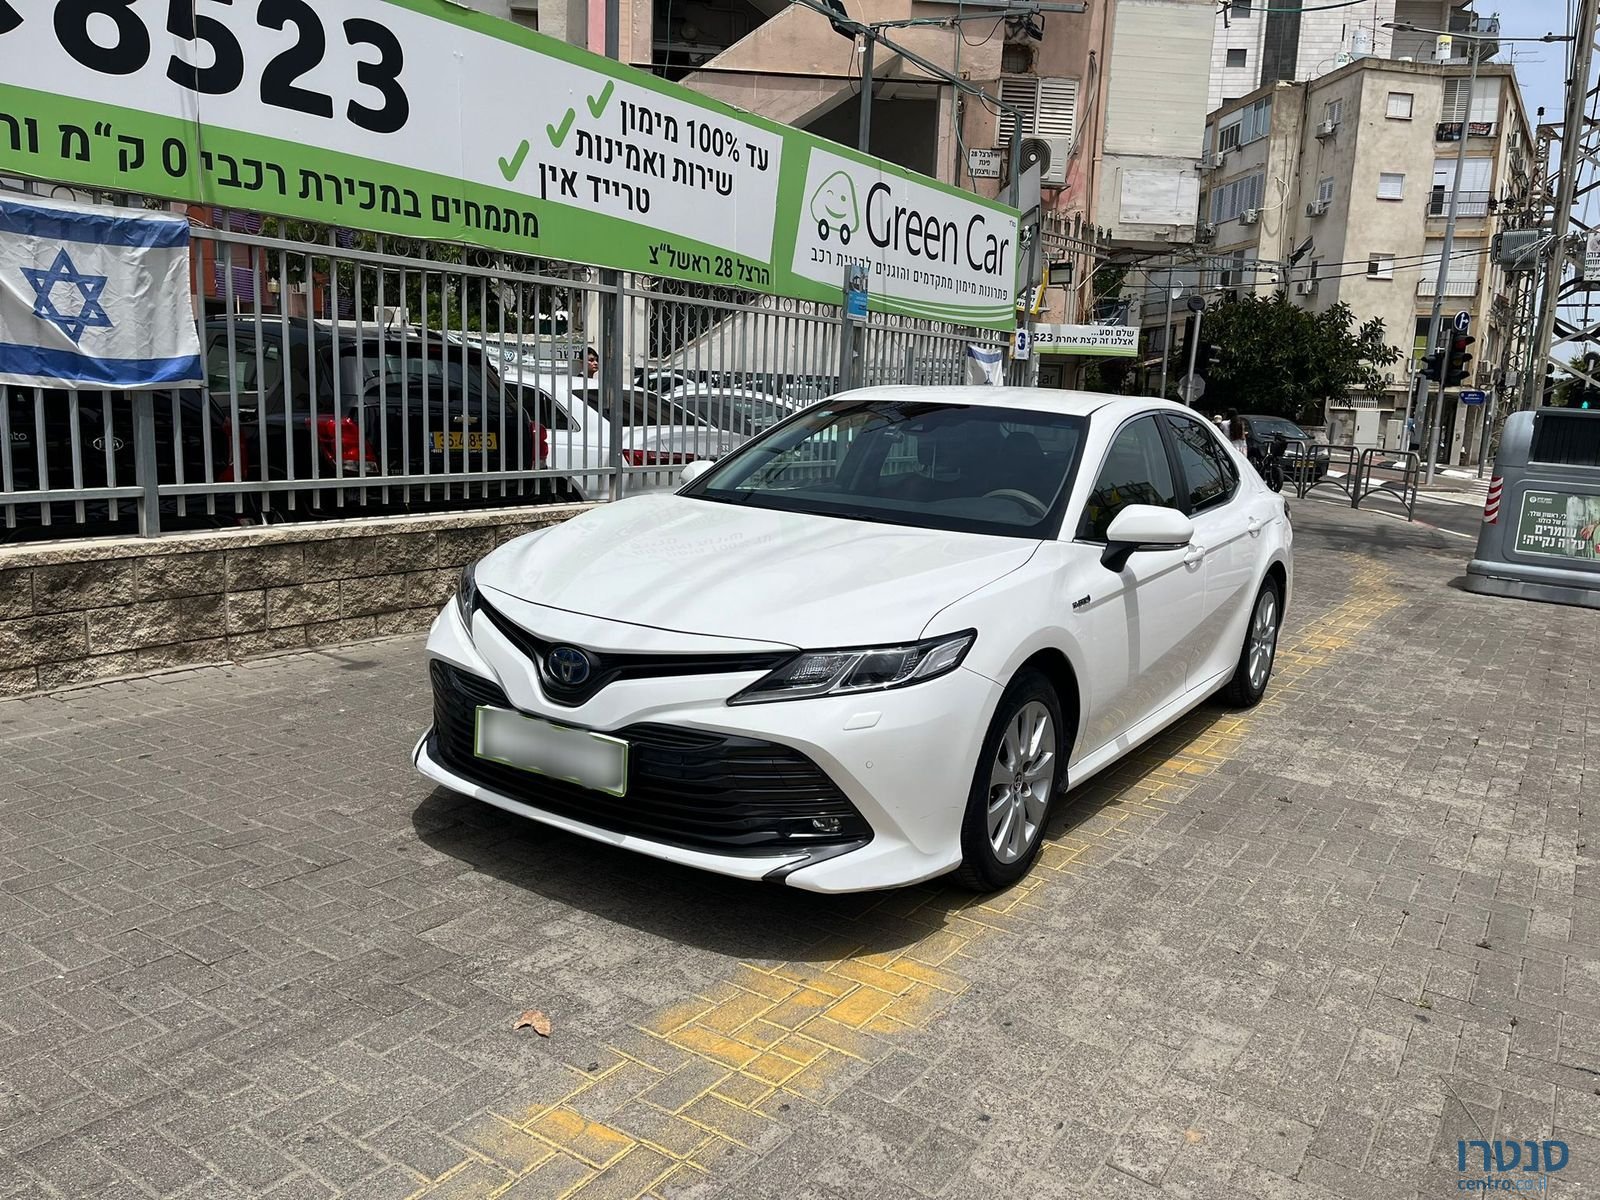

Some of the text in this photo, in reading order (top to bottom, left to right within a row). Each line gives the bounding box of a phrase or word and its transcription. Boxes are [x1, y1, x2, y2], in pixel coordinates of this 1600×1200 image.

[619, 99, 770, 172] עד 100% מימון
[162, 137, 188, 178] 0
[575, 128, 733, 197] שירות ואמינות
[201, 151, 288, 196] רכבי
[299, 168, 422, 219] במכירת
[538, 162, 651, 214] טרייד אין
[432, 193, 540, 239] מתמחים
[866, 181, 1010, 277] Green Car
[811, 247, 832, 265] רכב
[714, 256, 733, 279] 28
[736, 257, 771, 286] הרצל
[876, 262, 910, 281] והוגנים
[913, 270, 953, 290] מתקדמים
[955, 279, 977, 295] מימון
[979, 284, 1009, 301] פתרונות
[1017, 332, 1026, 350] 3
[1055, 335, 1134, 346] אצלנו זה קצת אחרת
[1116, 329, 1135, 338] שלם
[1522, 534, 1556, 548] נקייה!
[1535, 524, 1577, 538] שומרים
